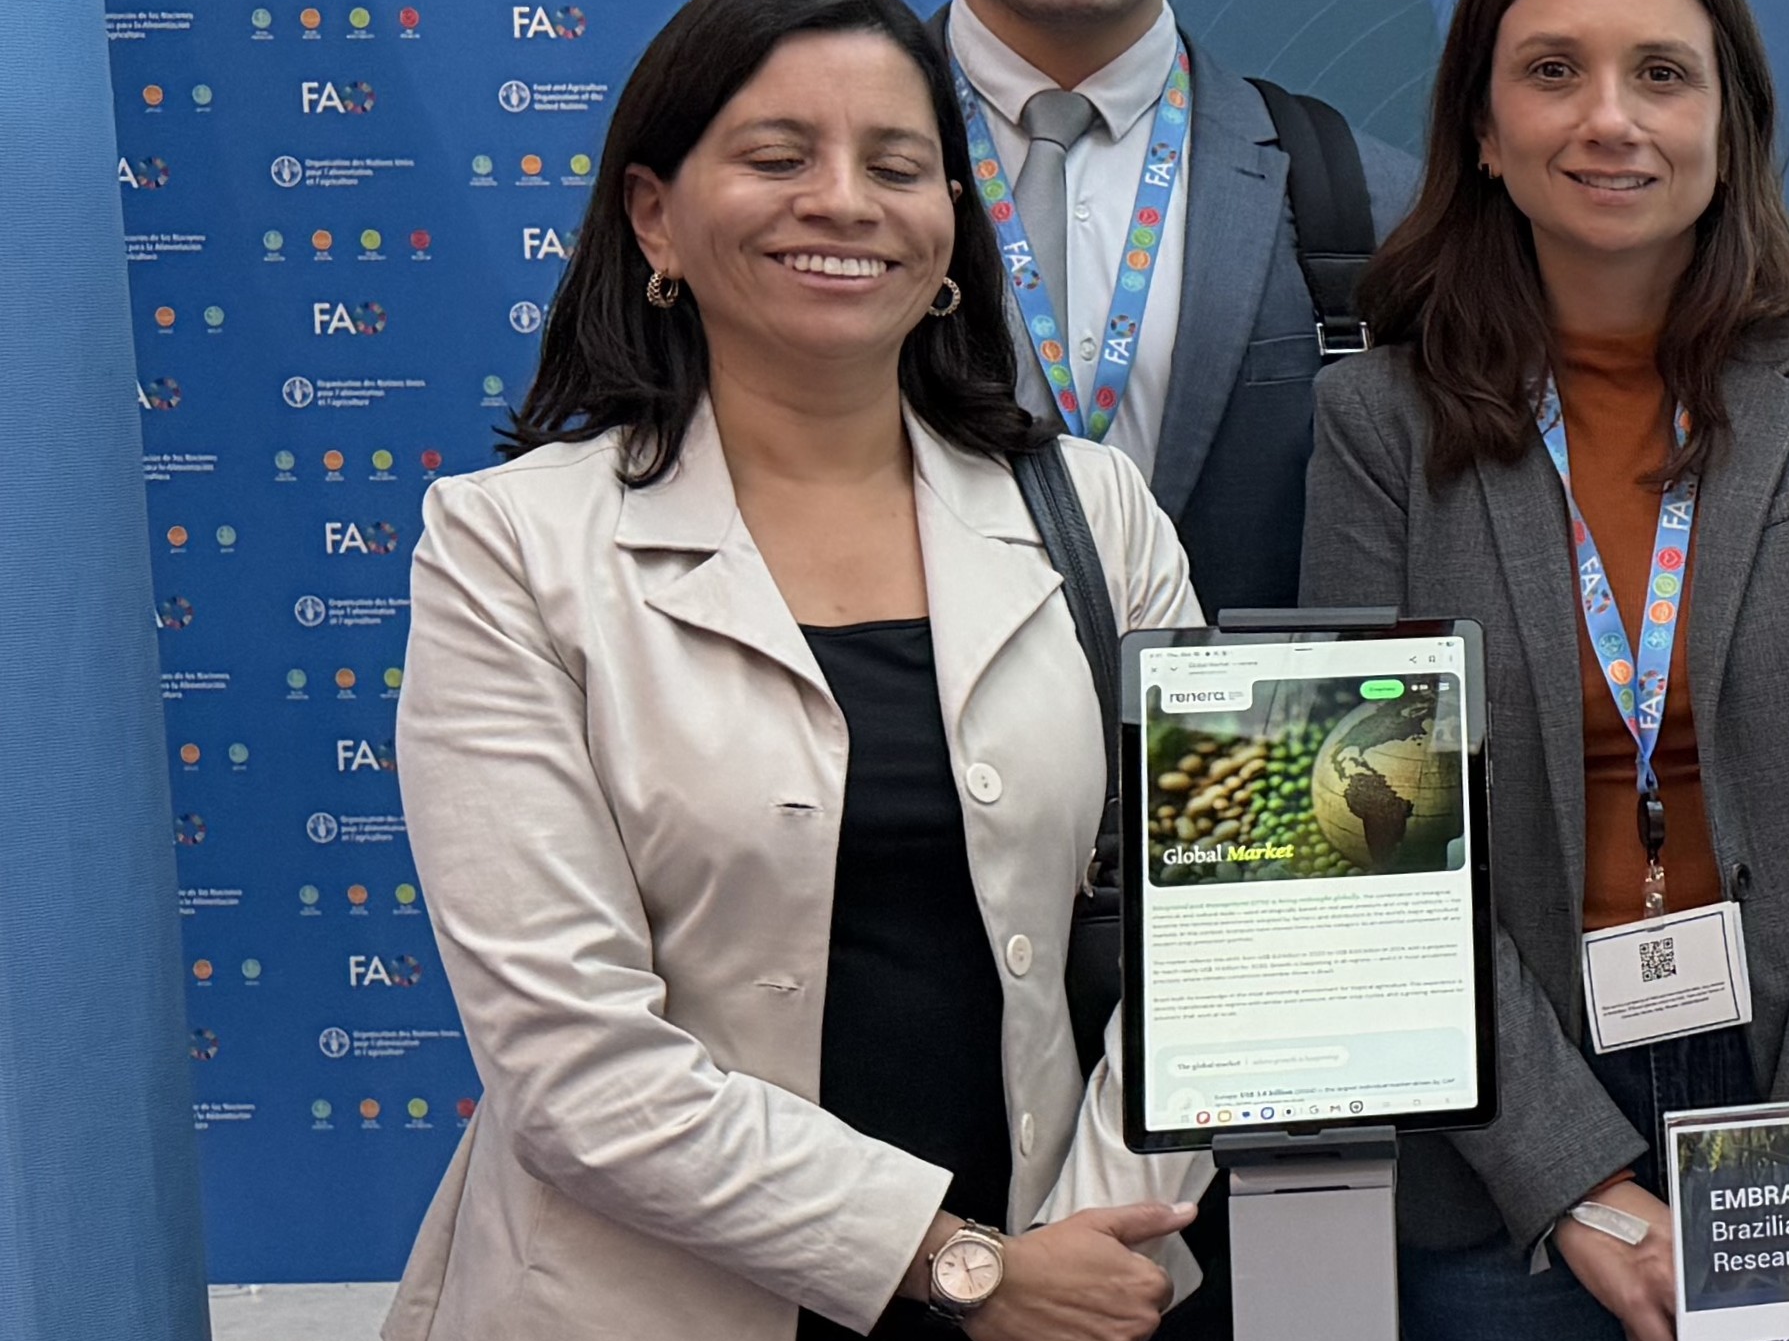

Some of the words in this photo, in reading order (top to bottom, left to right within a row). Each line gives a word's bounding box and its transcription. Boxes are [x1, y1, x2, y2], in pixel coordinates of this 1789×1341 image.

[1169, 690, 1225, 703] renera
[1163, 844, 1223, 867] Global
[1227, 841, 1295, 862] Market
